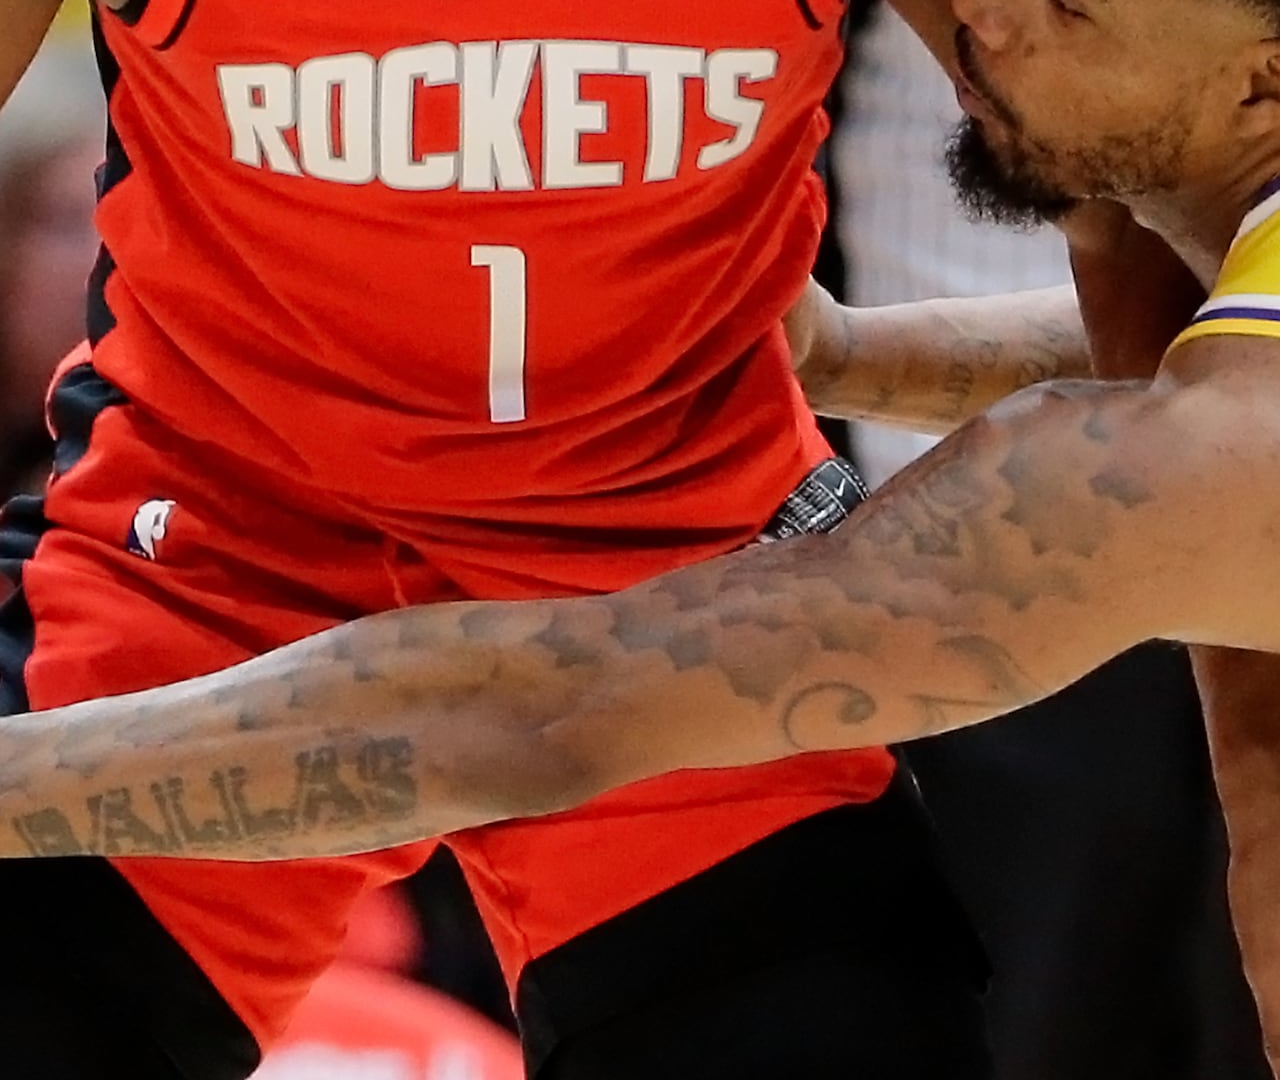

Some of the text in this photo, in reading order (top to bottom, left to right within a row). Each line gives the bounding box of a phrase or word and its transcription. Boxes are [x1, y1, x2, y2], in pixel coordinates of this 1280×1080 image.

[216, 39, 779, 193] ROCKETS
[470, 244, 527, 424] 1
[13, 735, 418, 857] DALLAS
